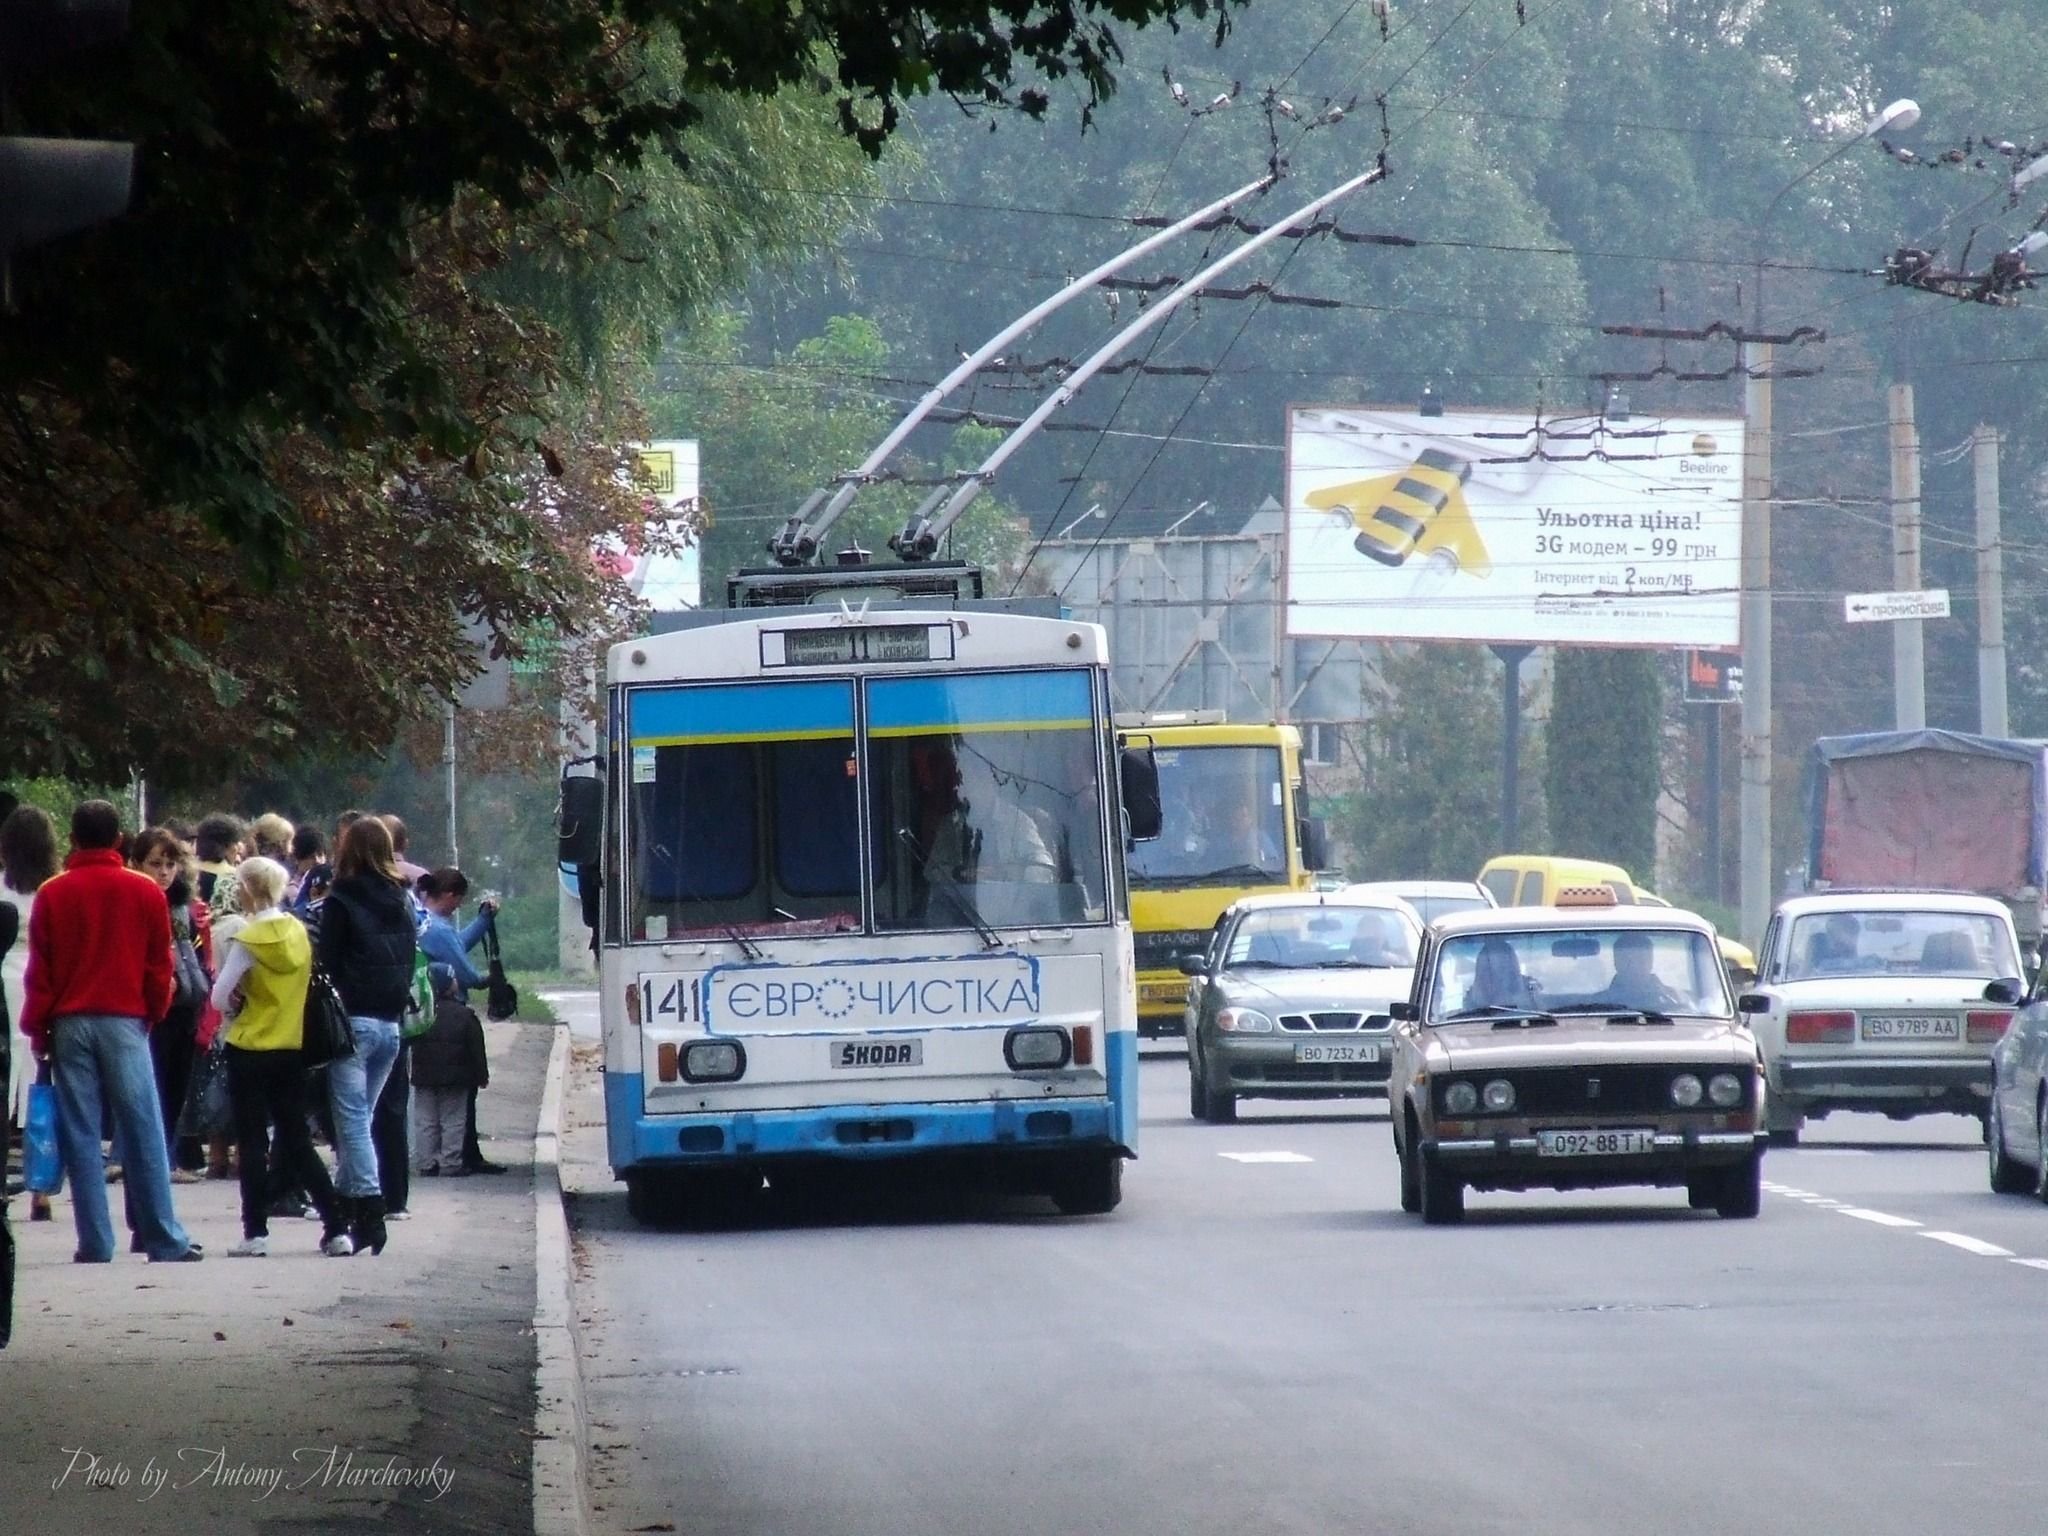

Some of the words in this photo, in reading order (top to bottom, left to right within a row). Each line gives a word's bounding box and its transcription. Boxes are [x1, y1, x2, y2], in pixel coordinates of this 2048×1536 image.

[1680, 459, 1729, 474] Beeline
[1537, 508, 1634, 529] Ульотна
[1640, 510, 1702, 532] ціна!
[1535, 535, 1563, 554] 3G
[1569, 541, 1628, 556] модем
[1652, 538, 1678, 556] 99
[1685, 543, 1717, 560] грн
[1535, 571, 1595, 586] Інтернет
[1599, 572, 1619, 585] від
[1625, 567, 1637, 586] 2
[848, 630, 870, 660] 11
[643, 978, 701, 1024] 141
[728, 976, 1035, 1020] ЄВРОЧИСТКА
[1897, 1020, 1929, 1034] 9789
[841, 1043, 913, 1066] ŠKODA
[1326, 1047, 1354, 1060] 7232
